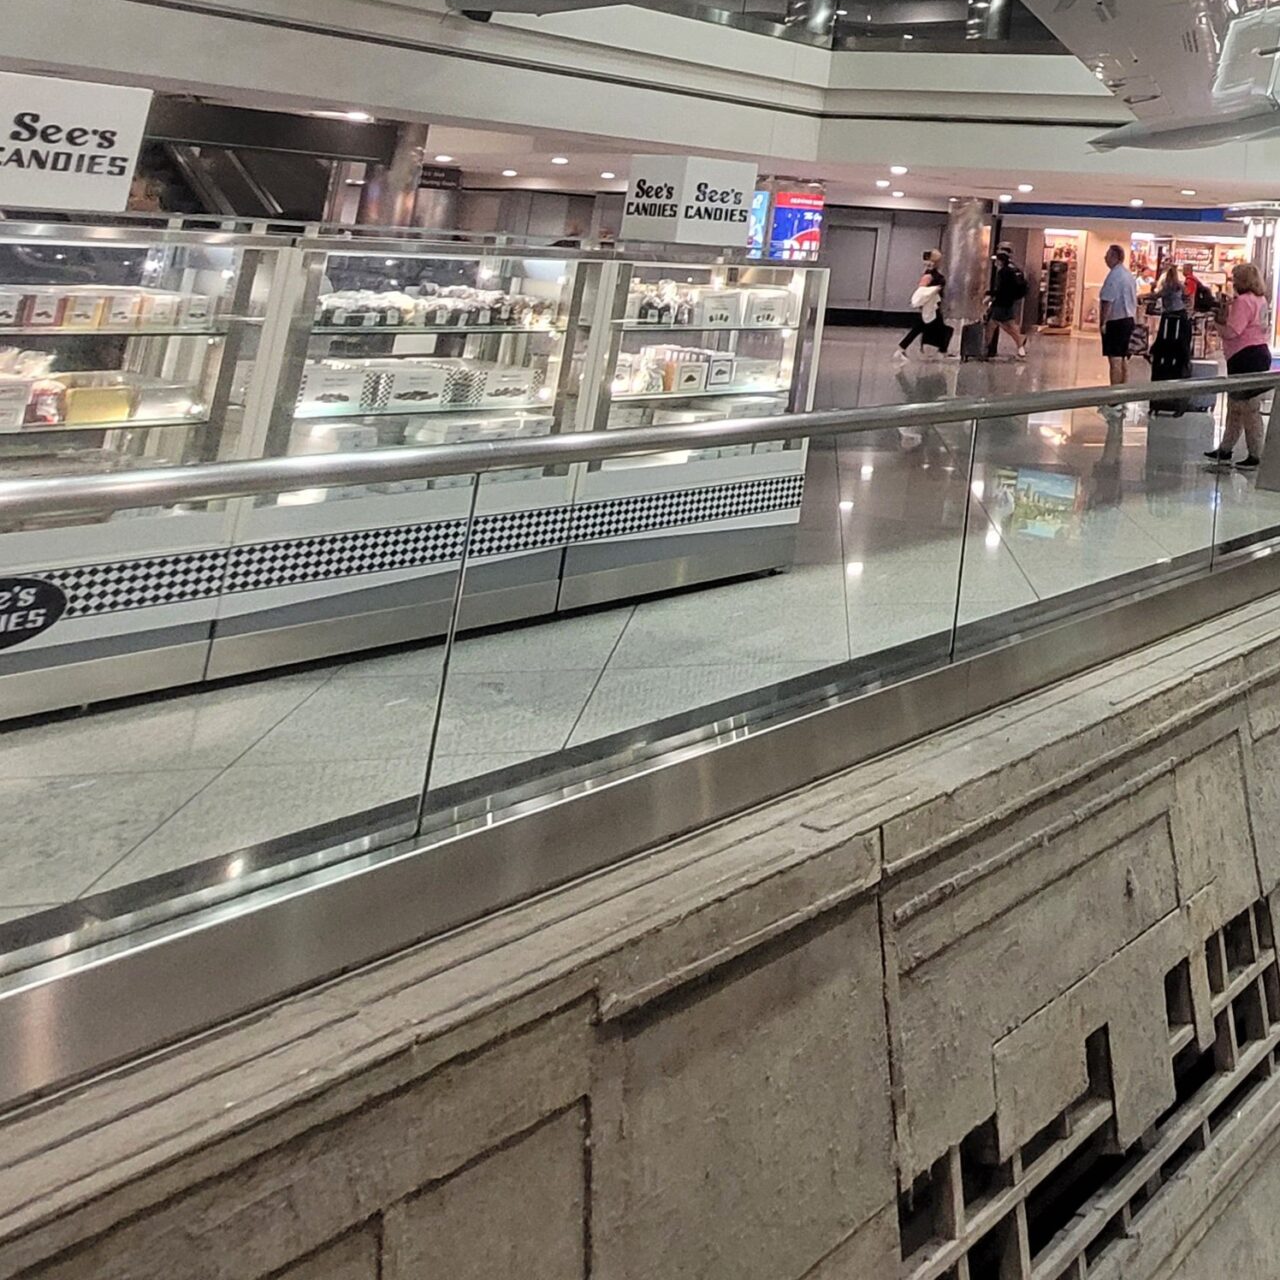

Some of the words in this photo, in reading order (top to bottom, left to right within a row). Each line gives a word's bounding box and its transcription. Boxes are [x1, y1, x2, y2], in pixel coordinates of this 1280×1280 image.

[10, 112, 118, 149] See's
[635, 179, 675, 200] See's
[695, 182, 744, 205] See's
[626, 202, 679, 218] CANDIES
[684, 206, 749, 223] CANDIES
